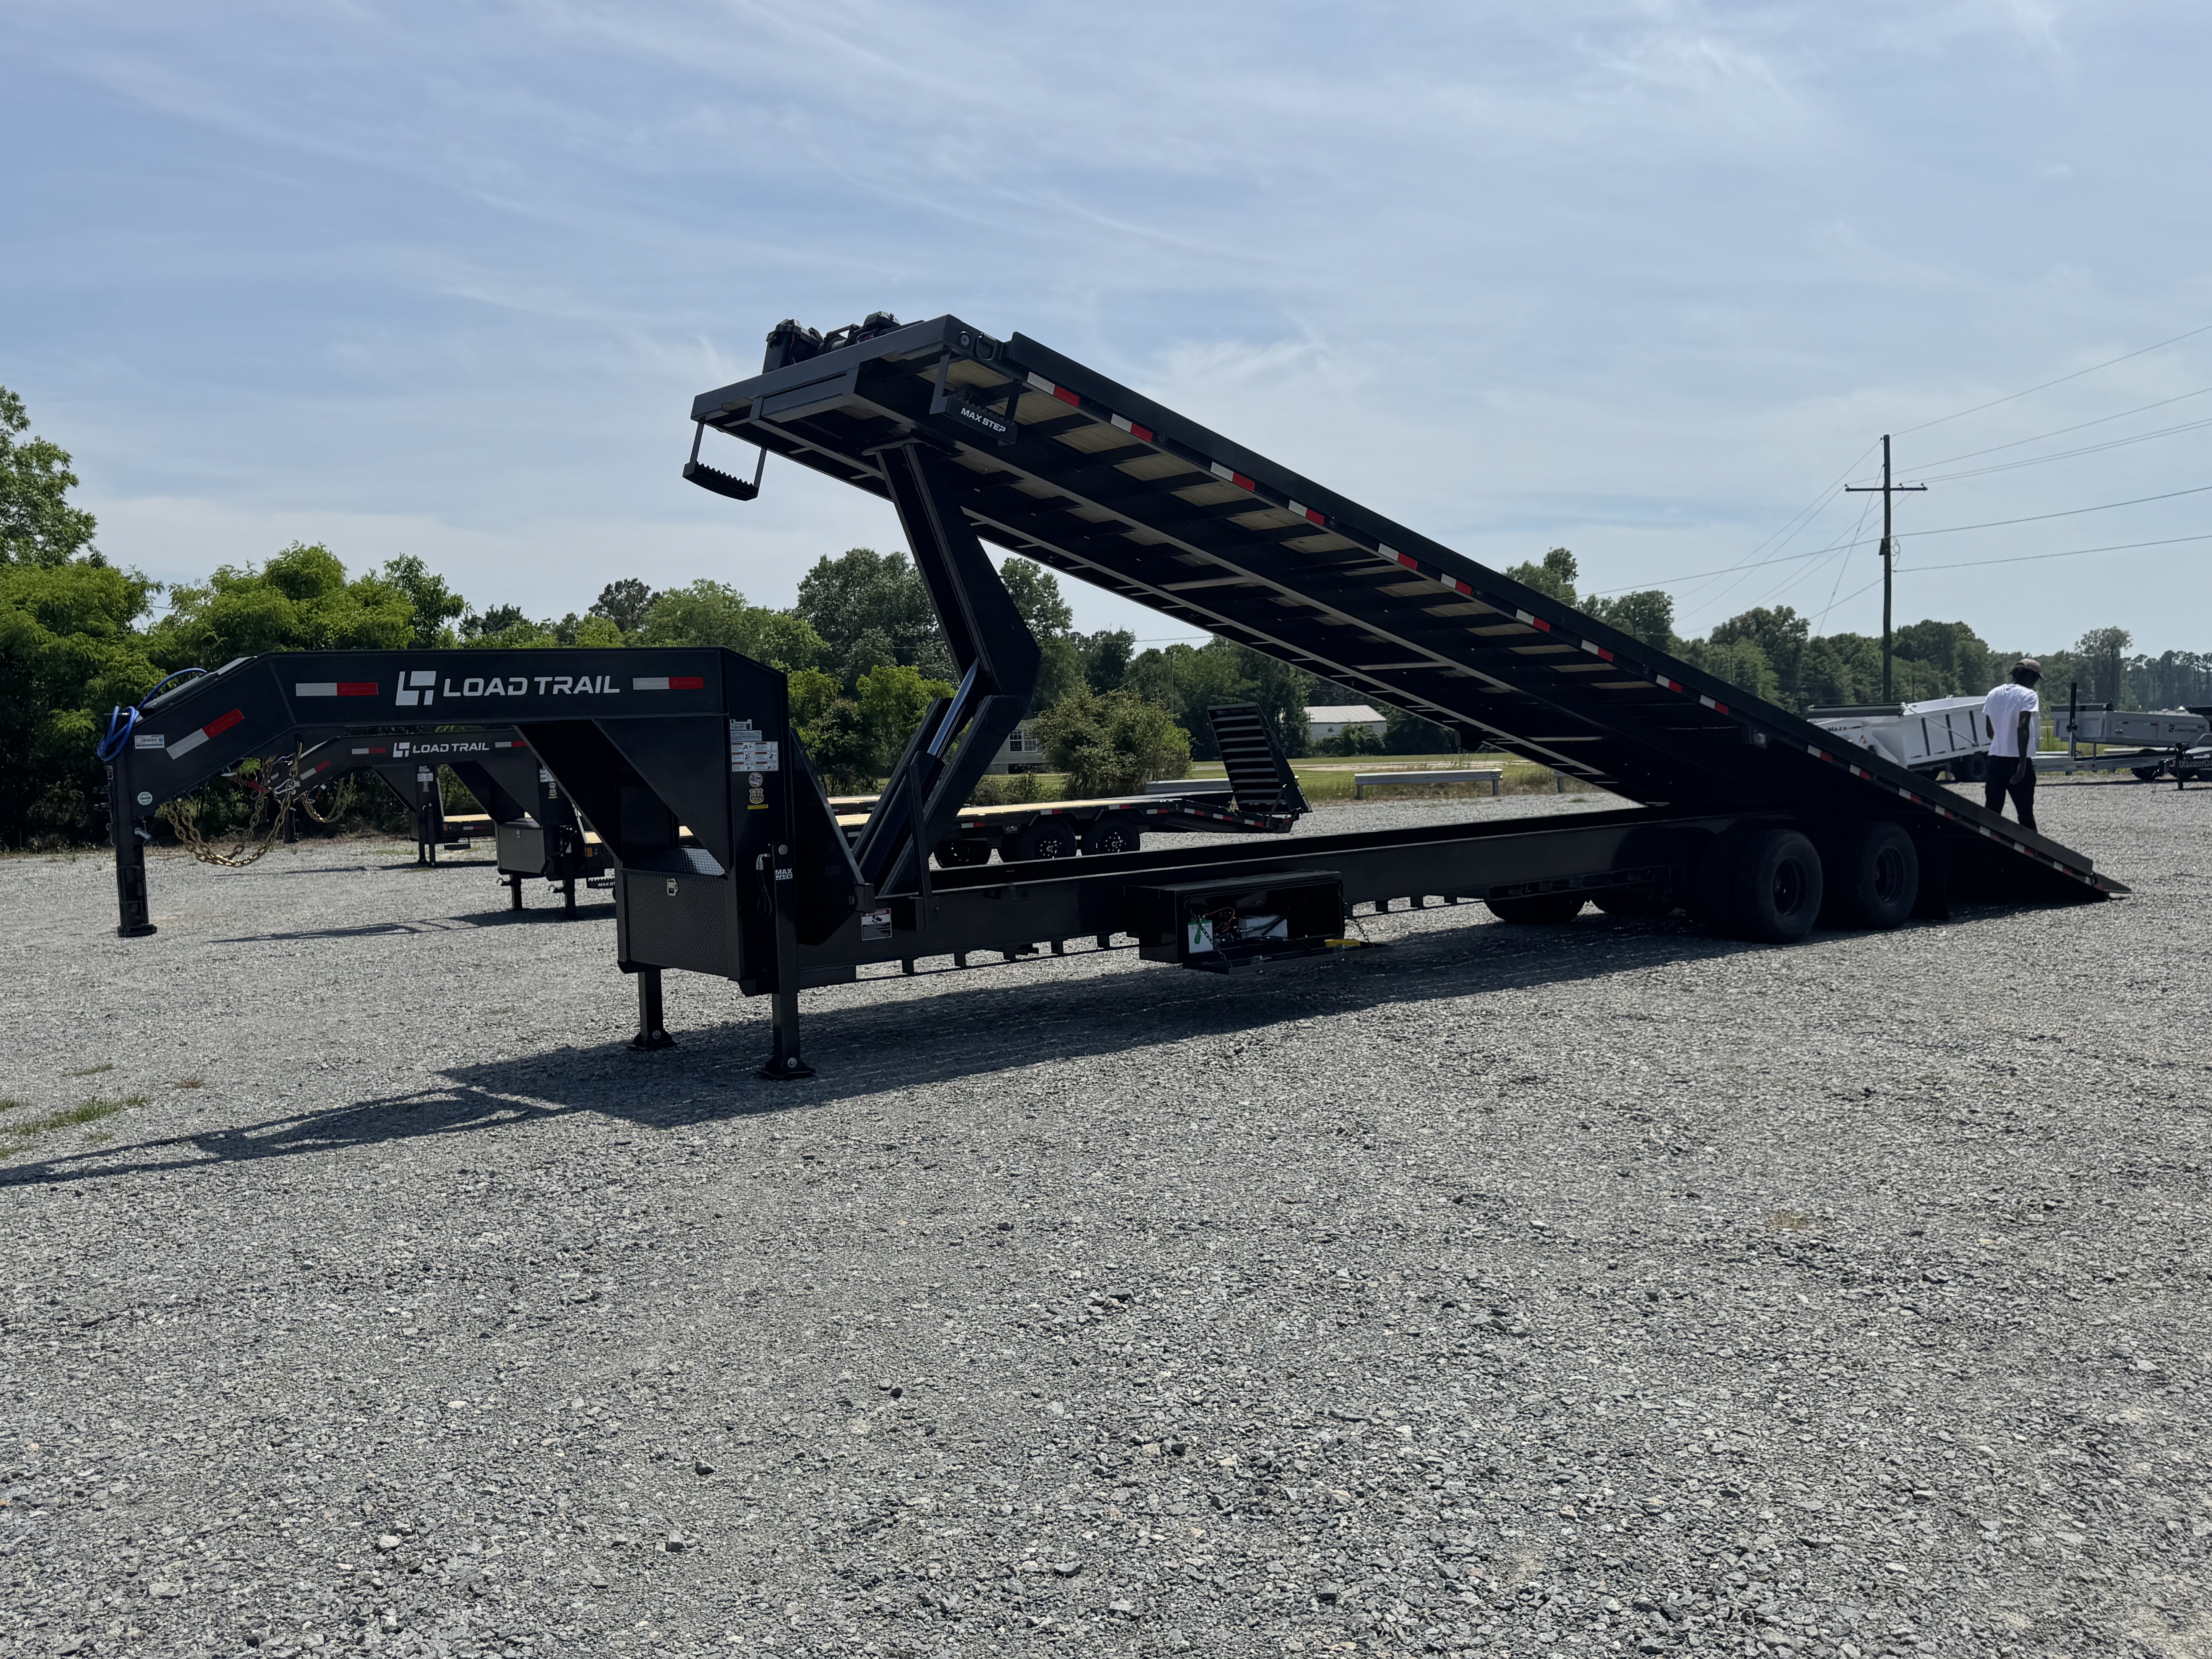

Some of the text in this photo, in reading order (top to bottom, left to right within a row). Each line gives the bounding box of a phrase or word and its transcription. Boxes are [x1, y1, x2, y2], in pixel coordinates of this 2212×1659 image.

[961, 407, 1006, 432] MAX STEP
[443, 678, 528, 697] LOAD
[534, 676, 620, 695] TRAIL
[413, 744, 449, 753] LOAD
[452, 742, 489, 752] TRAIL
